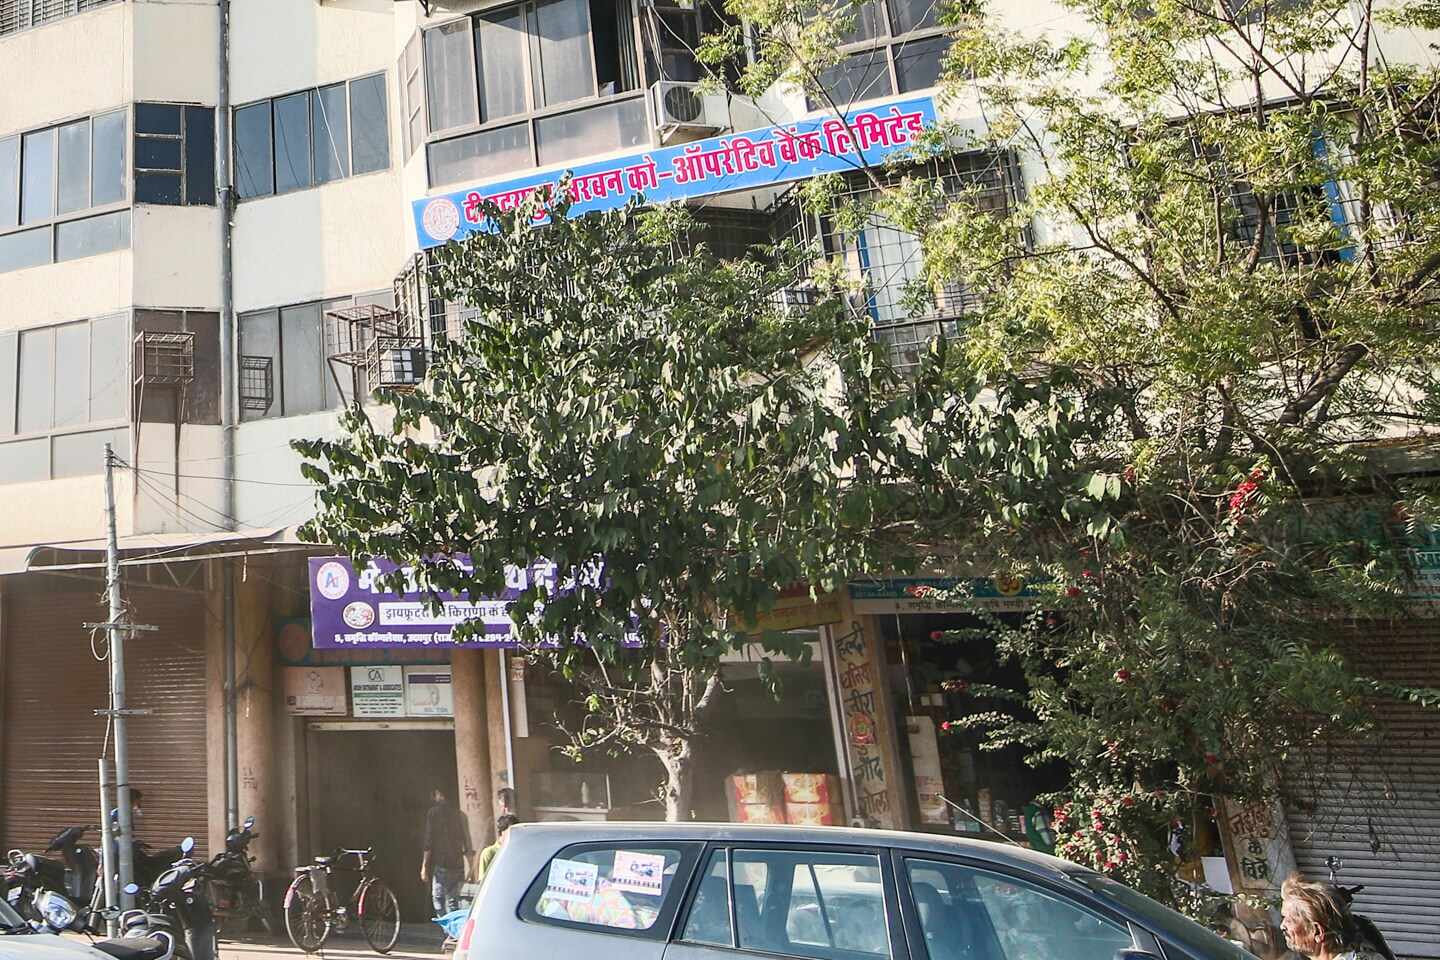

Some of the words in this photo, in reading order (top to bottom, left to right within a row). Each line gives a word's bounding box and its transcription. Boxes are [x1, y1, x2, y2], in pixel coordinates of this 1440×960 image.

[824, 107, 924, 156] लिमिटेड
[835, 621, 867, 661] हल्दी
[368, 669, 382, 681] CA
[844, 689, 875, 717] जीरा
